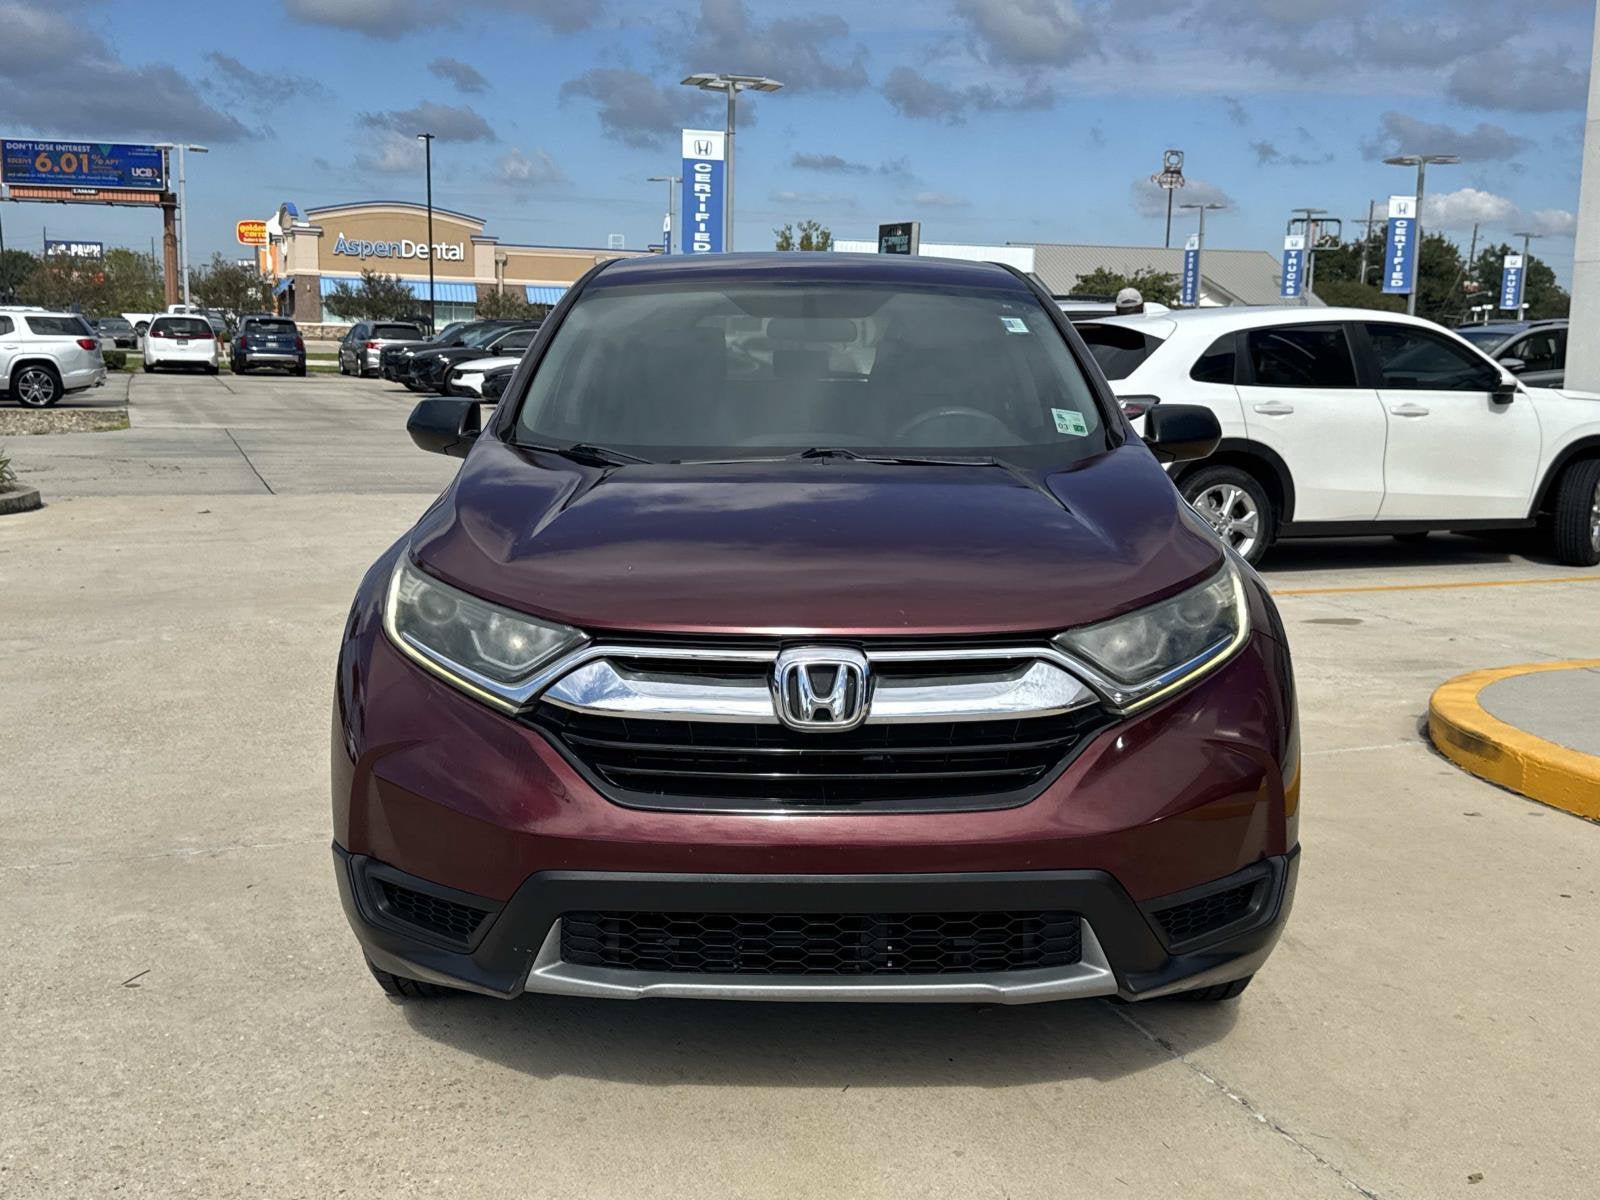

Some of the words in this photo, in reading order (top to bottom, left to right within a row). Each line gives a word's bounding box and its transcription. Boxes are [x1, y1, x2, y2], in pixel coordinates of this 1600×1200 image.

[6, 142, 33, 150] DON'T
[34, 143, 54, 151] LOSE
[35, 152, 88, 173] 6.01
[131, 168, 152, 177] UCB
[694, 162, 712, 252] CERTIFIED
[1391, 220, 1408, 287] CERTIFIED
[1286, 251, 1298, 295] TRUCKS
[1505, 268, 1516, 306] TRUCKS
